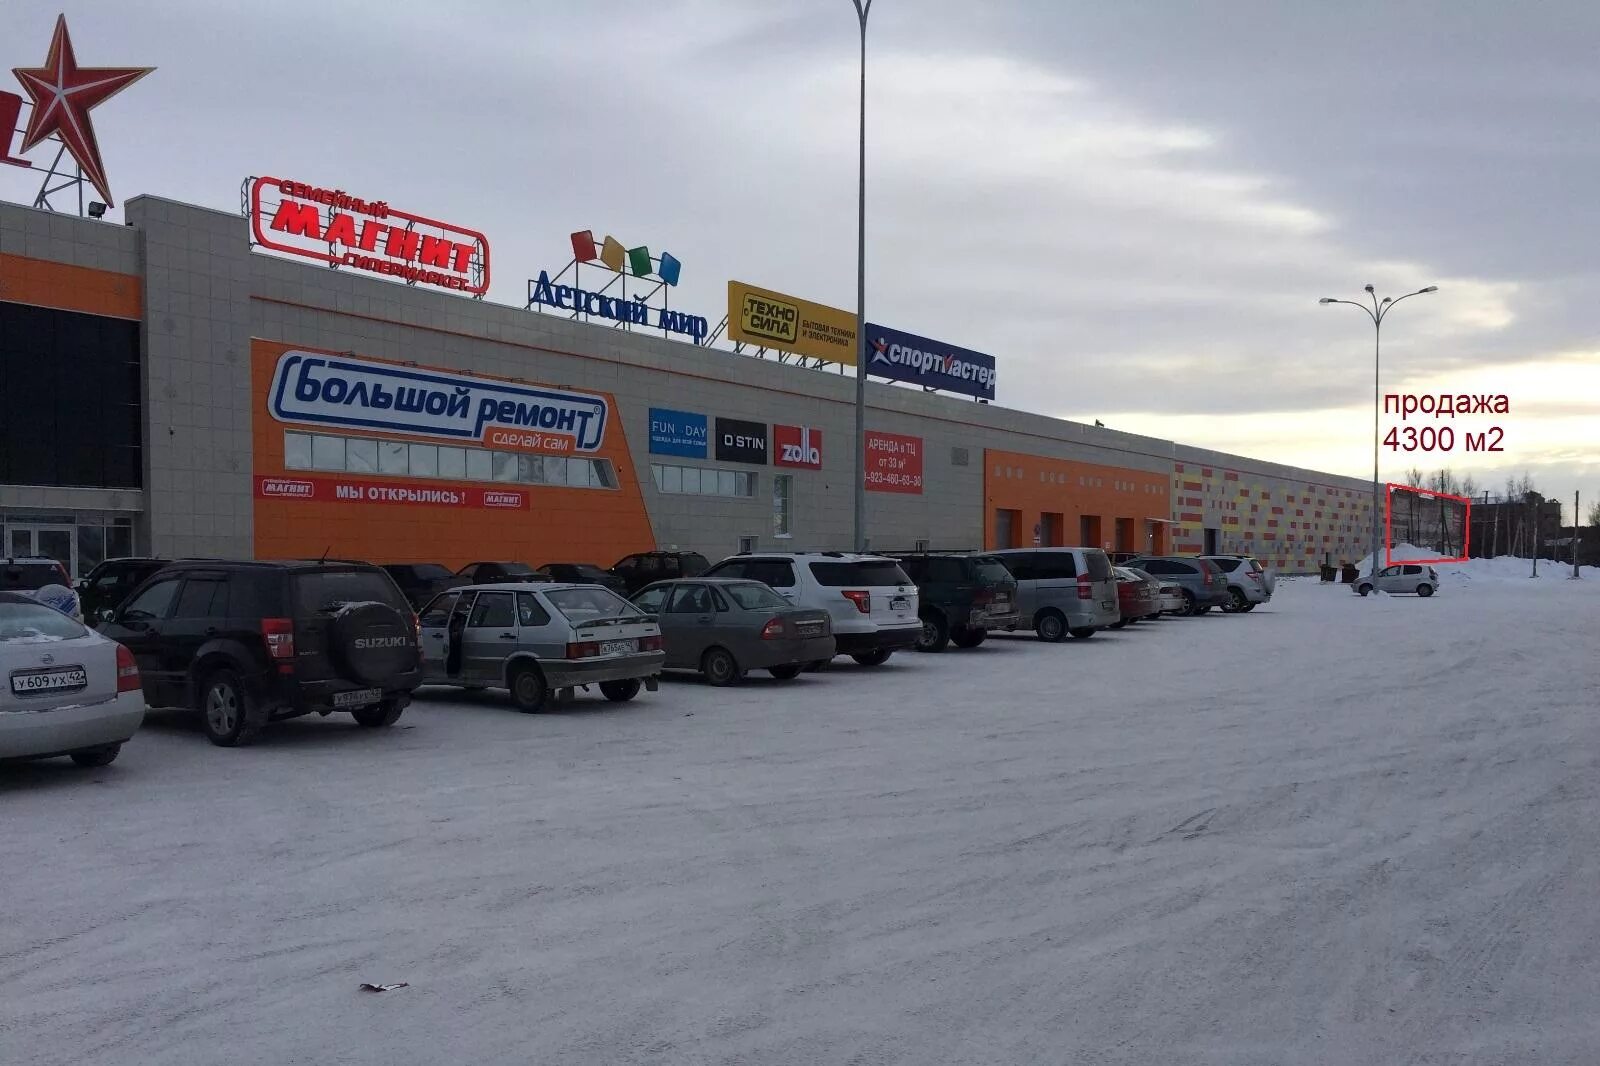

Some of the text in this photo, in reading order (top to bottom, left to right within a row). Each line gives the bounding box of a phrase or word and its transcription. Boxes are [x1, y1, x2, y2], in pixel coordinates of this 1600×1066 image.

[279, 180, 388, 219] СЕМЕЙНЫЙ
[270, 199, 477, 274] МАГНИТ
[342, 252, 470, 291] ГИПЕРМАРКЕТ
[531, 270, 708, 346] Детский мир
[747, 299, 795, 322] ТЕХНО
[750, 315, 790, 336] СИЛА
[802, 319, 856, 339] БЫТОВАЯ ТЕХНИКА
[802, 329, 849, 347] И ЭЛЕКТРОНИКА
[652, 421, 706, 437] FUN DAY
[492, 432, 569, 451] сделай сам
[868, 438, 899, 453] АРЕНДА
[905, 443, 916, 457] ТЦ
[878, 458, 887, 467] от
[888, 457, 897, 469] 33
[265, 483, 311, 494] МАГНИТ
[336, 485, 466, 505] МЫ ОТКРЫЛИСЬ!
[354, 636, 407, 649] SUZUKI
